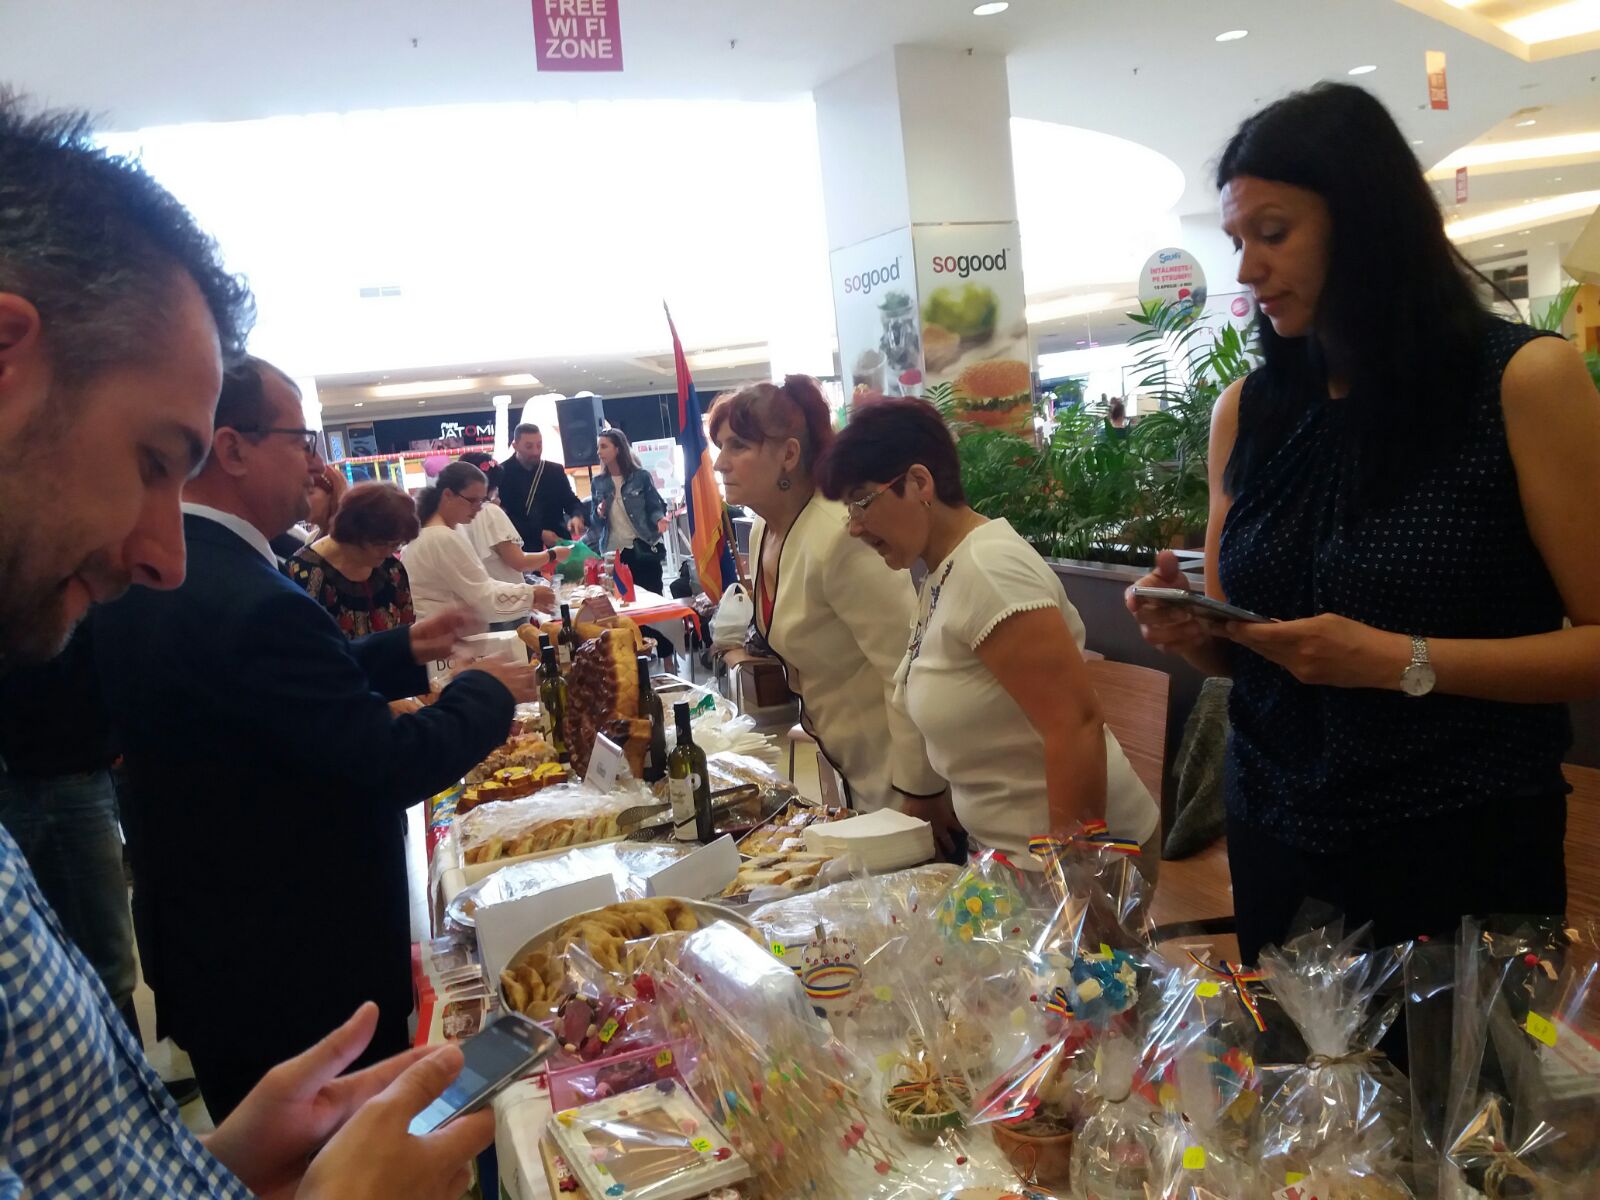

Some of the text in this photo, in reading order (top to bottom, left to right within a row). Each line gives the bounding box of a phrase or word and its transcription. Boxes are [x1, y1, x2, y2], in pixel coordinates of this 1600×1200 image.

[545, 0, 607, 16] FREE
[548, 17, 606, 37] WI FI
[545, 39, 613, 59] ZONE
[932, 248, 1007, 278] sogood
